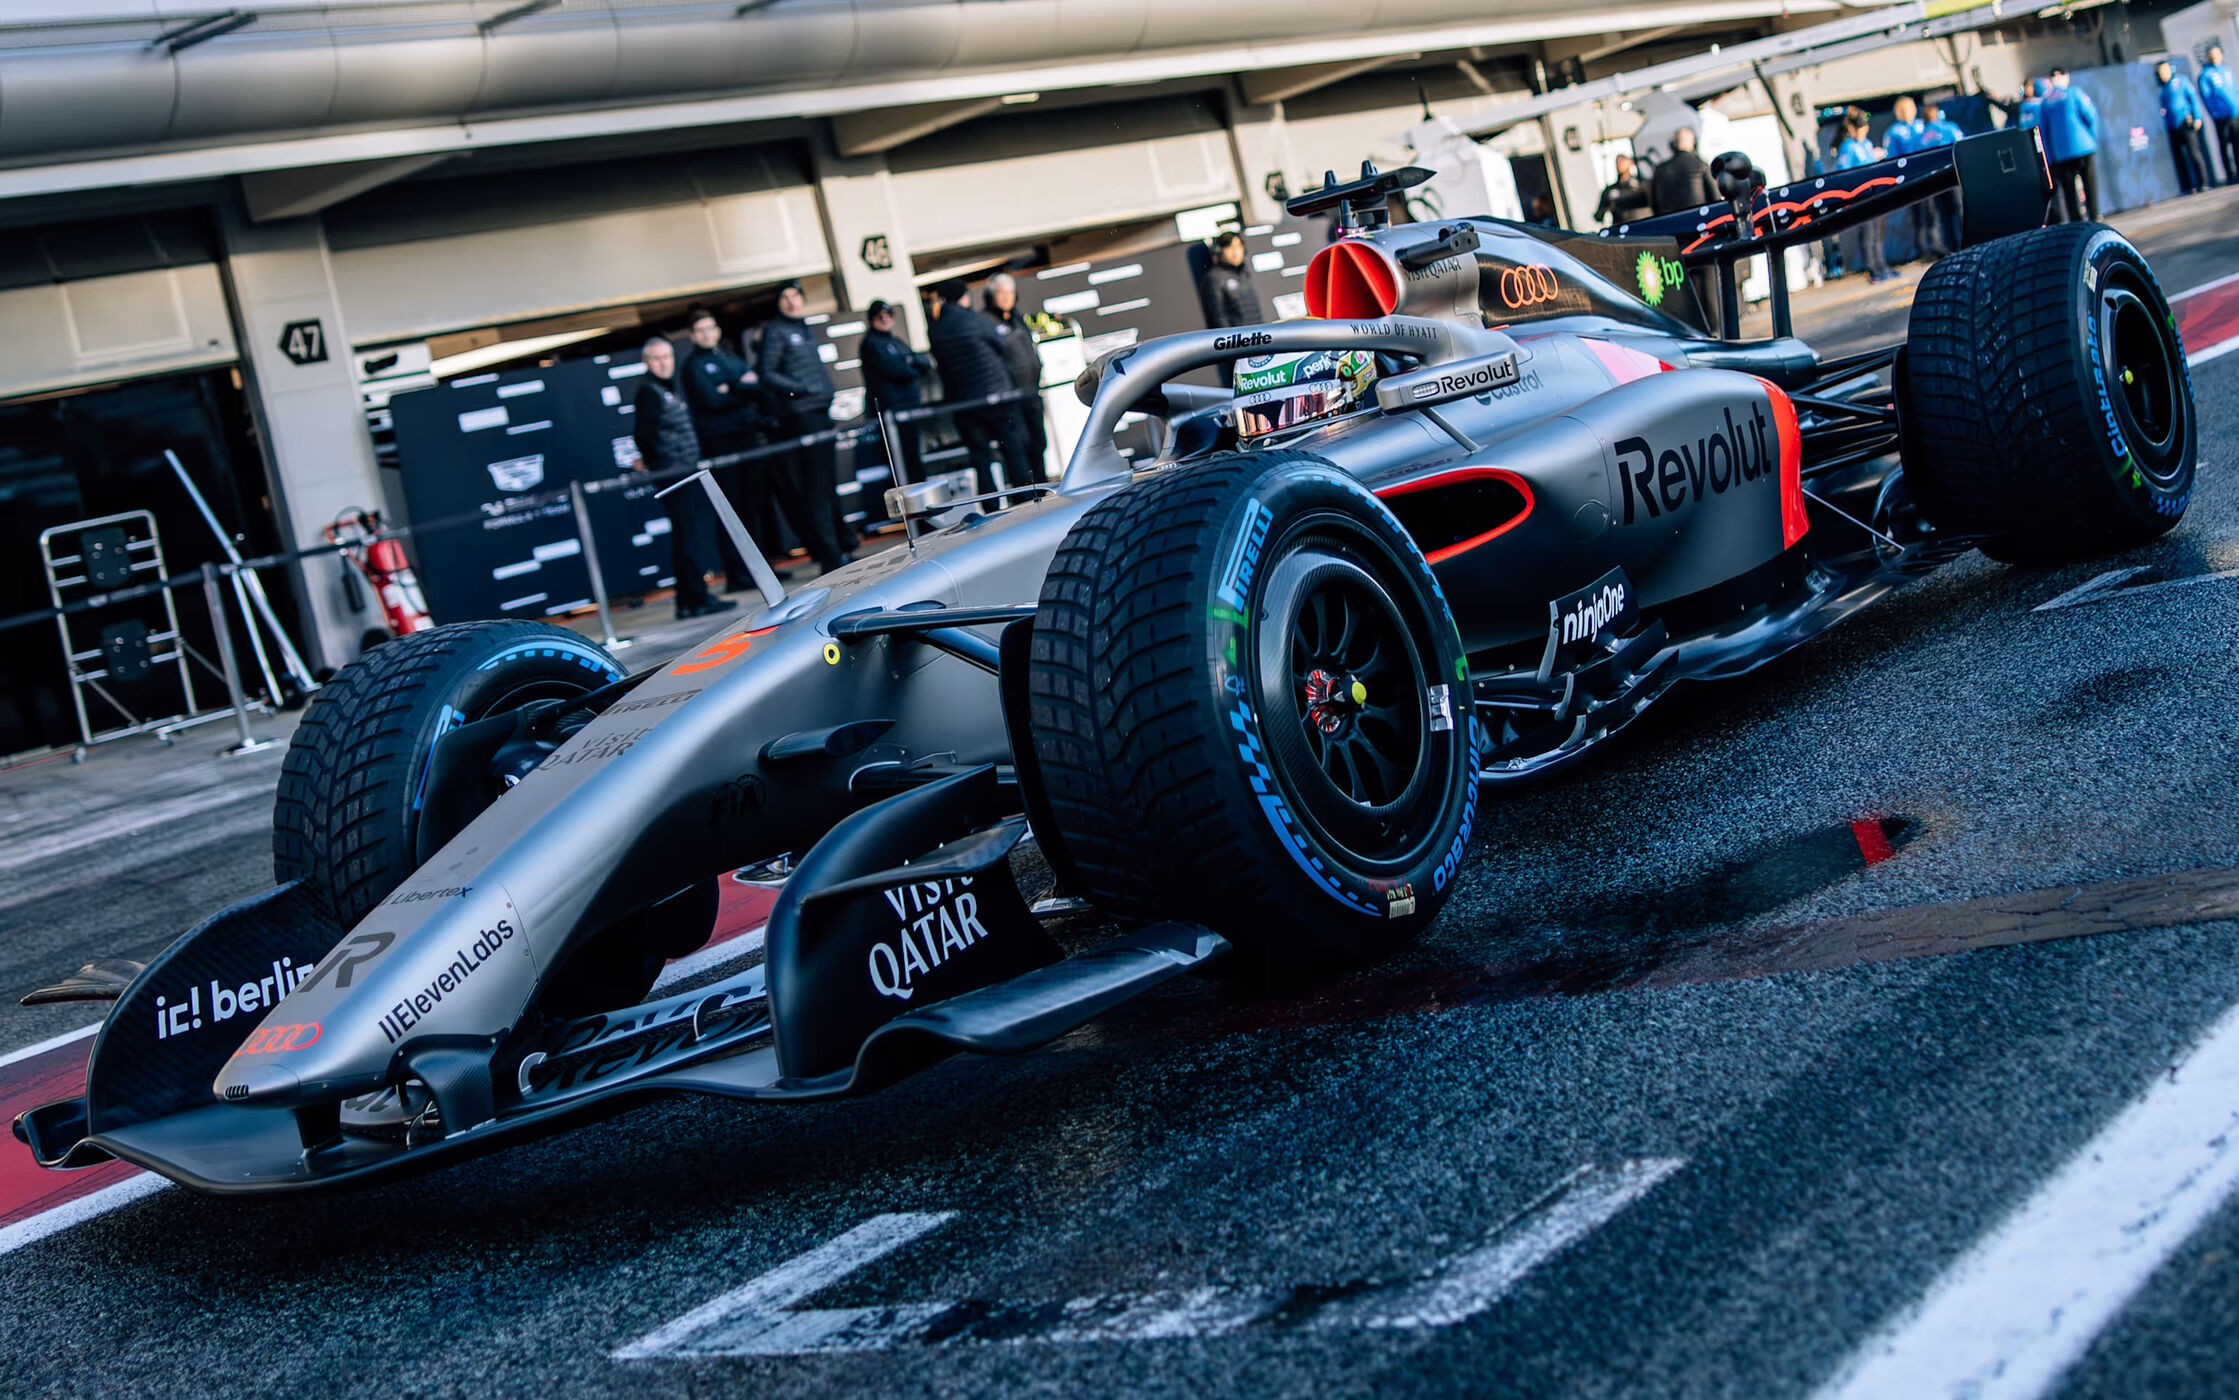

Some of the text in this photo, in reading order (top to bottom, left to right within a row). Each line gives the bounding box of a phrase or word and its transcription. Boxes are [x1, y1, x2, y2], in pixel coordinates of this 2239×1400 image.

[1661, 256, 1684, 290] bp
[288, 325, 320, 359] 47
[1214, 332, 1272, 350] Gillette
[1351, 323, 1437, 339] WORLD OF HYATT
[1239, 370, 1286, 392] Revolut
[1441, 361, 1513, 393] Revolut
[1614, 401, 1771, 526] Revolut
[1218, 498, 1274, 613] PIRELLI
[671, 625, 779, 675] 5
[537, 742, 633, 770] QATAR
[391, 886, 473, 905] Libertex
[869, 893, 988, 999] QATAR
